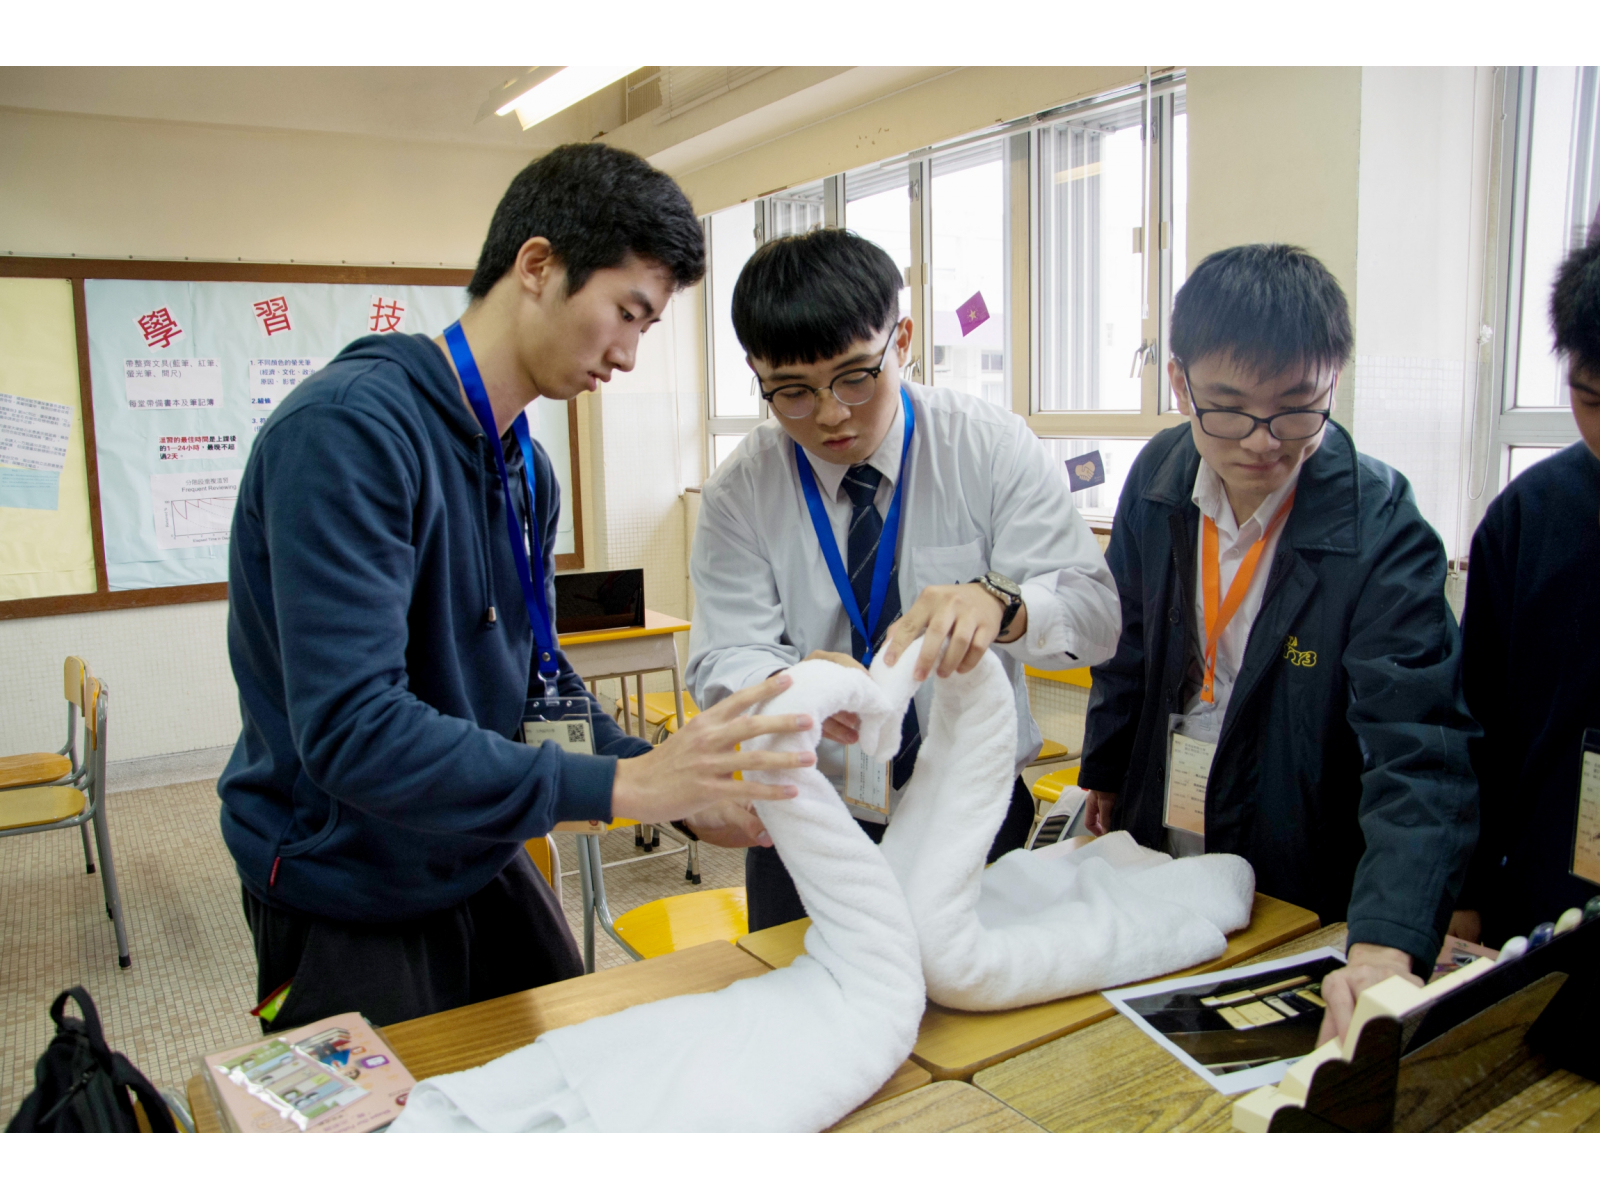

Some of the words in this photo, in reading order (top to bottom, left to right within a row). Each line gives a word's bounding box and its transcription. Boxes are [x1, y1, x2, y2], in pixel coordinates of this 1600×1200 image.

[137, 307, 182, 348] 學
[254, 296, 292, 336] 習
[370, 297, 405, 333] 技
